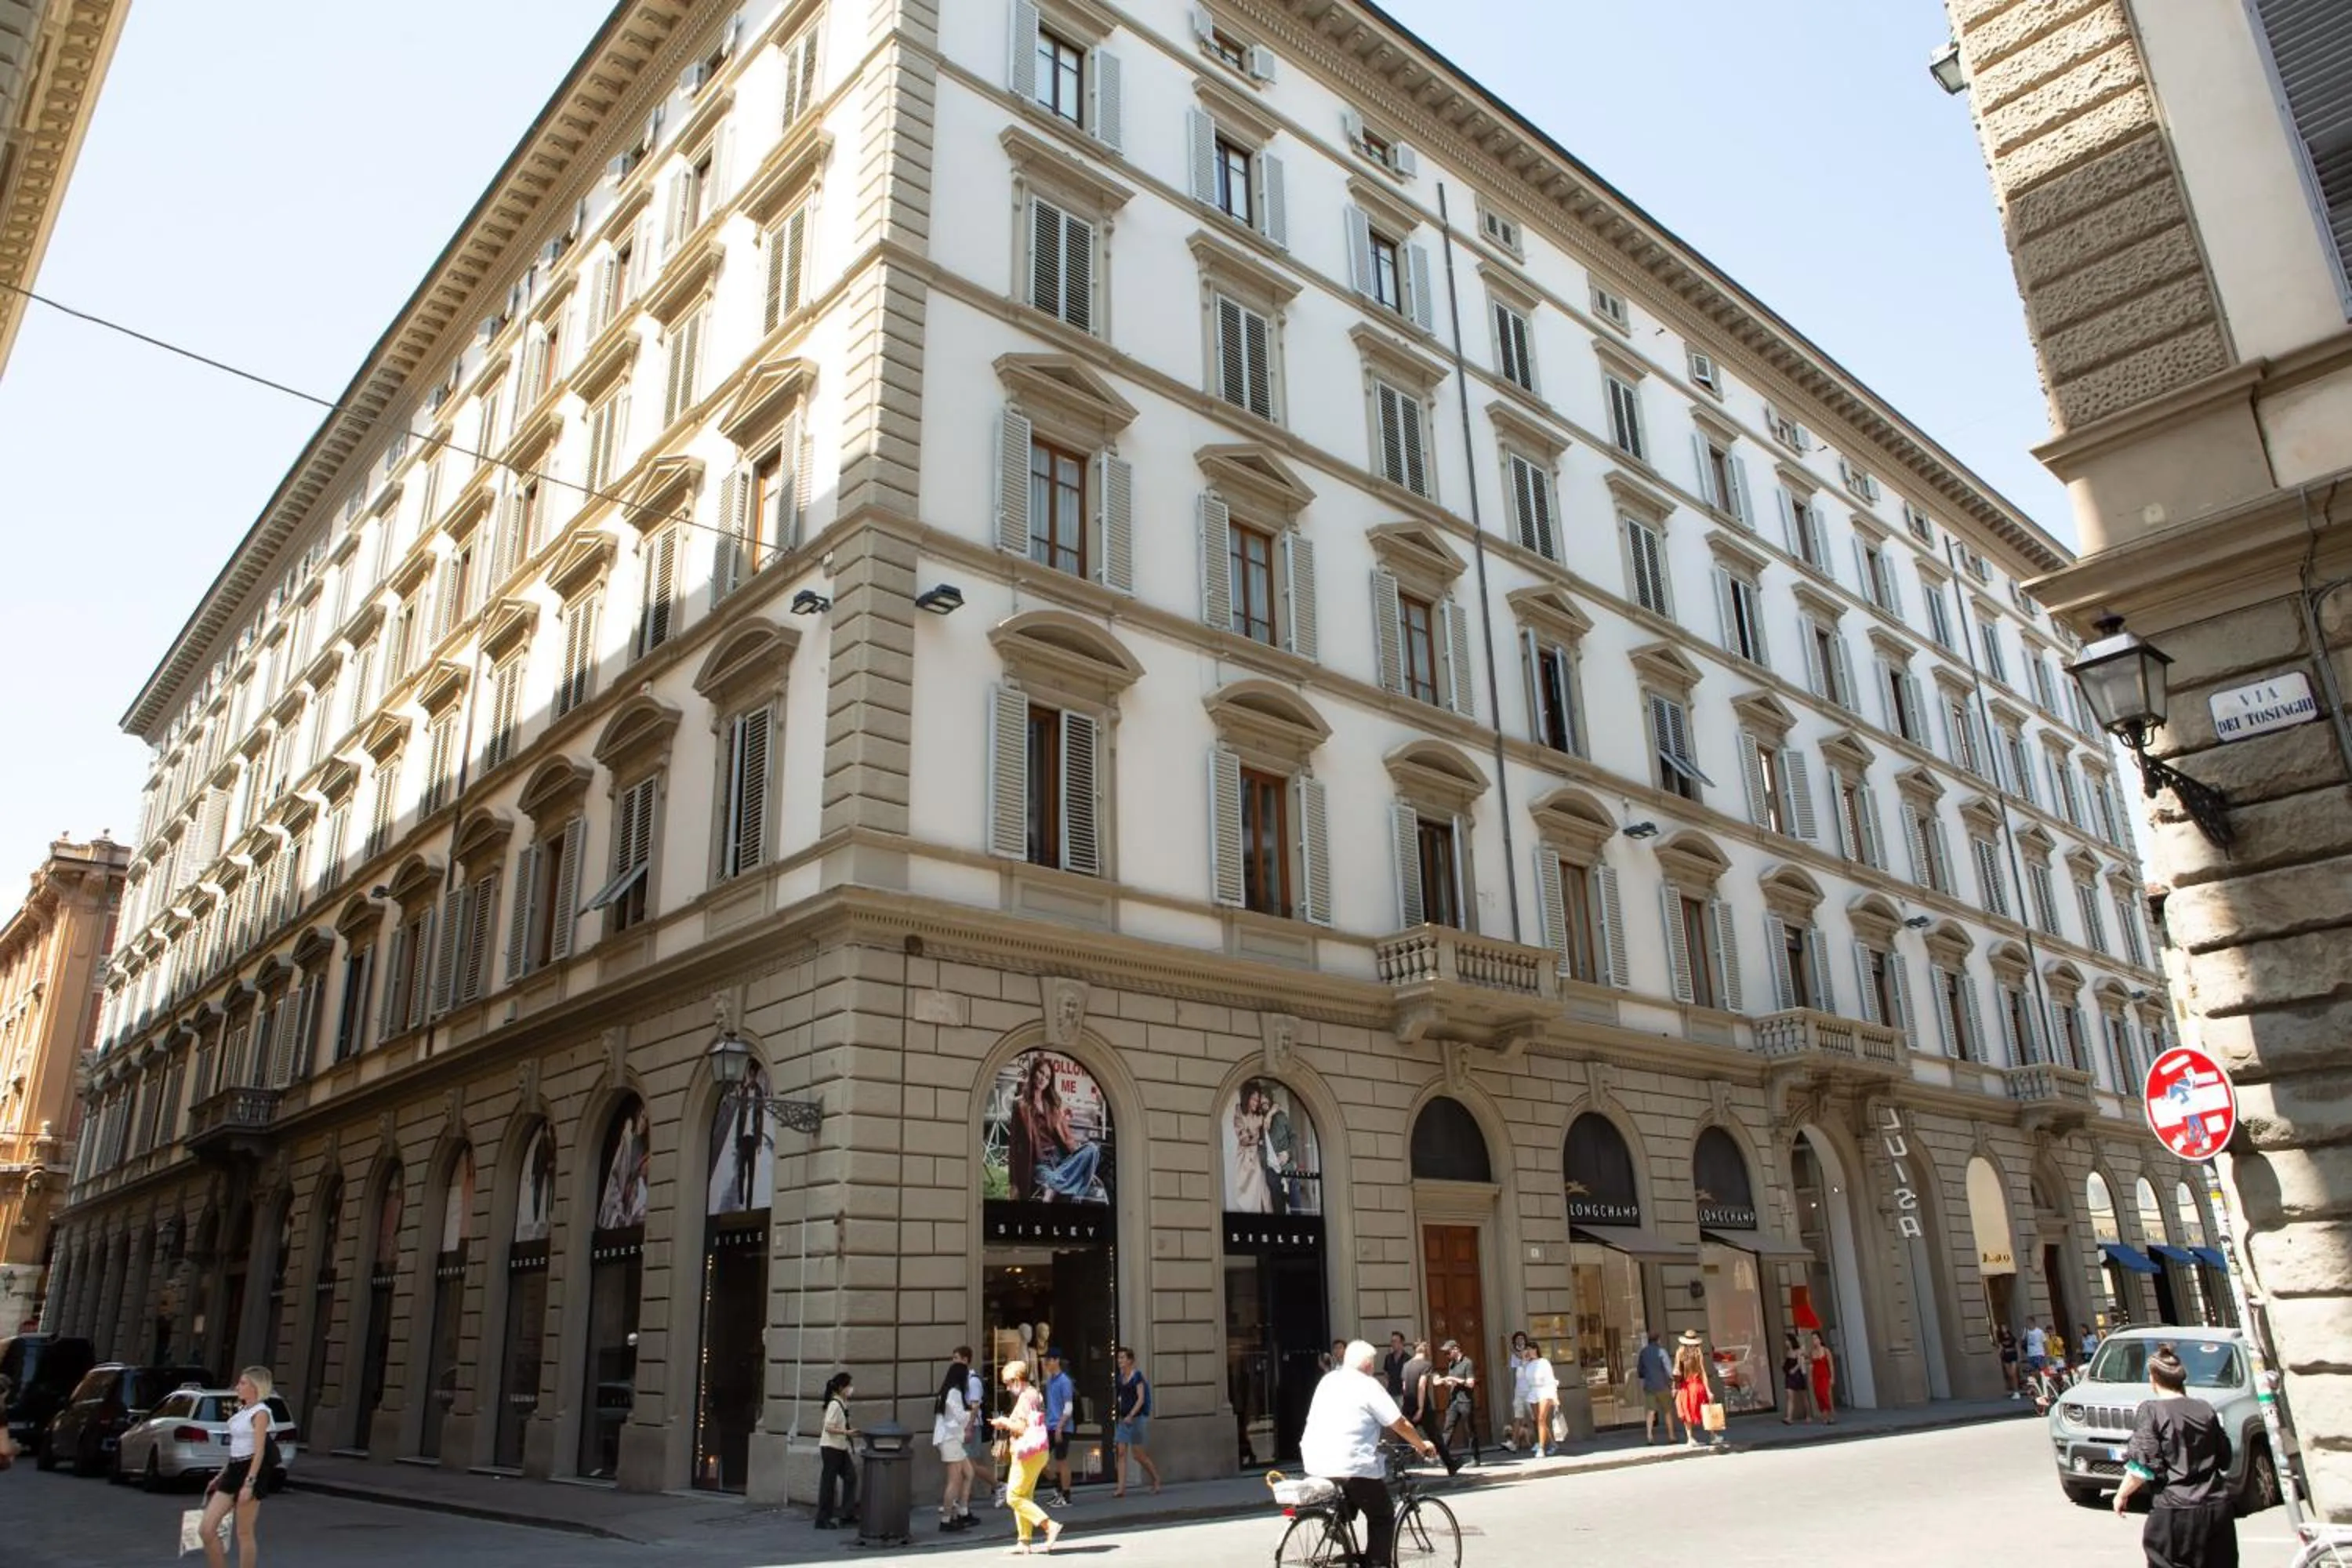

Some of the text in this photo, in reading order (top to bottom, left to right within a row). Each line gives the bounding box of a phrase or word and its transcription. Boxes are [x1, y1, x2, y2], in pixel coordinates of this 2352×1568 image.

[2238, 686, 2279, 706] VIA
[2216, 697, 2314, 735] DEI TOSINGHI
[1052, 1059, 1086, 1076] OLLO
[1061, 1079, 1076, 1094] ME
[1569, 1203, 1639, 1218] LONGCHAMP
[1698, 1209, 1757, 1223] LONGCHAMP
[997, 1223, 1095, 1237] SISLEY
[714, 1231, 764, 1247] SISLE
[1232, 1232, 1315, 1245] SISLEY
